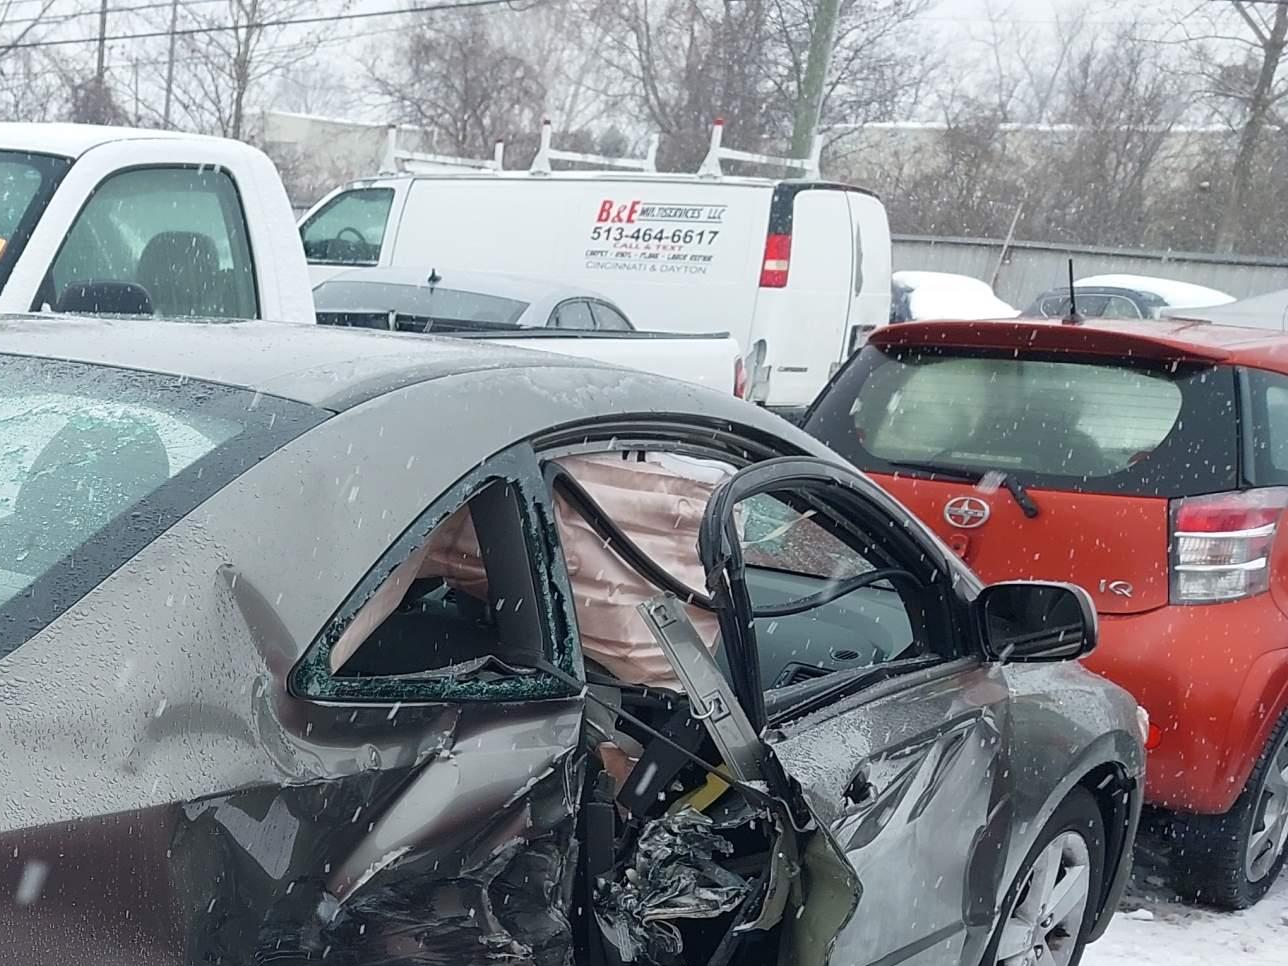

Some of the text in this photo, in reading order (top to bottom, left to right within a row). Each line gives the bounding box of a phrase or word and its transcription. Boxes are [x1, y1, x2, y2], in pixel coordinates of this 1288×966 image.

[596, 199, 641, 223] B&E
[707, 208, 726, 220] LLC
[590, 226, 720, 245] 513-464-6617
[613, 242, 640, 250] CALL
[585, 260, 648, 271] CINCINNATI
[660, 264, 707, 274] DAYTON
